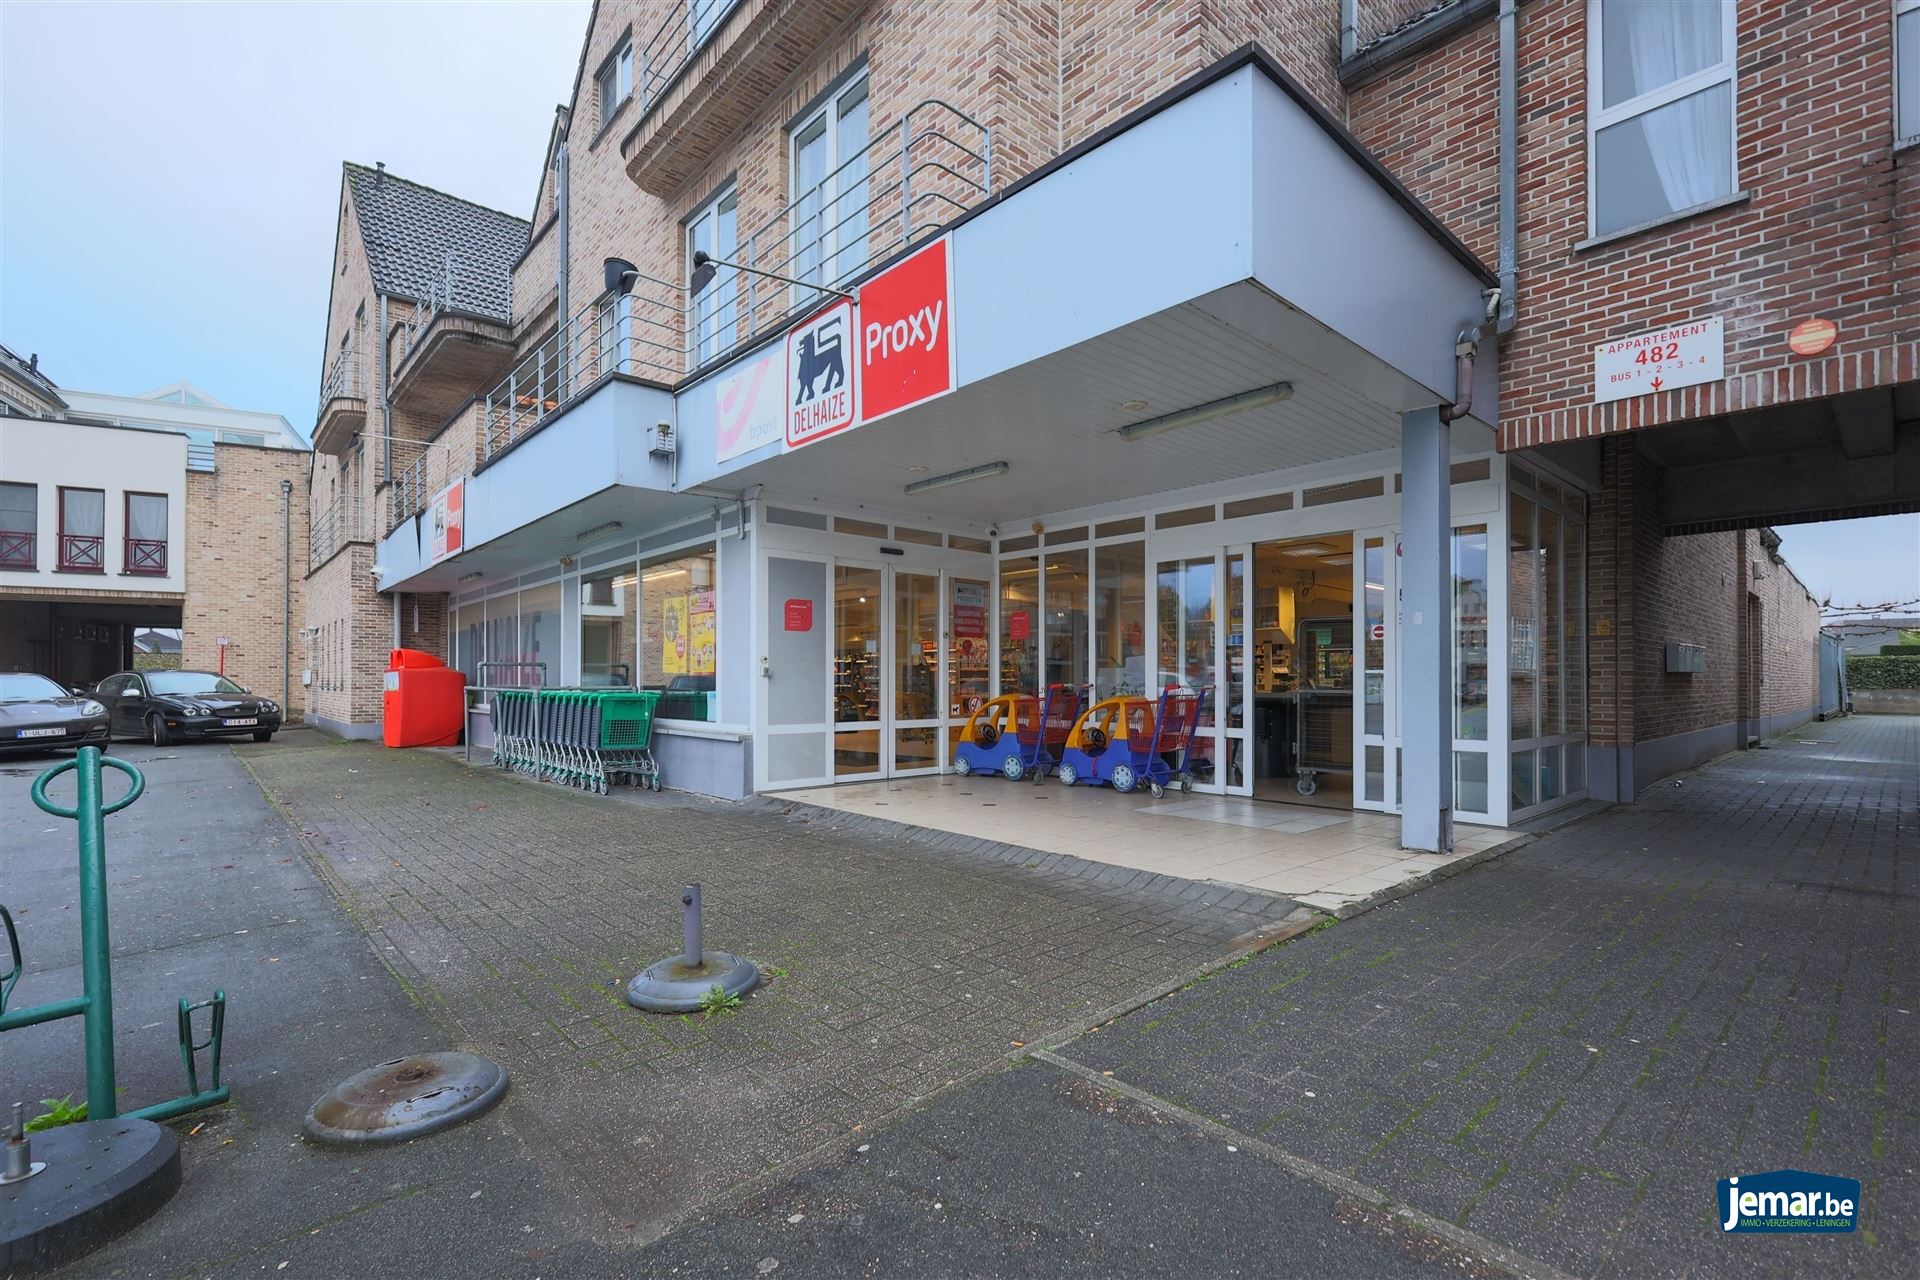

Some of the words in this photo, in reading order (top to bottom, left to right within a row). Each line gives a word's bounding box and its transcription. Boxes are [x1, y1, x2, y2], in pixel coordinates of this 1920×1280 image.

[865, 299, 943, 367] Proxy
[1608, 323, 1708, 354] APPARTEMENT
[1610, 372, 1631, 383] BUS
[1656, 364, 1662, 373] 2
[1677, 360, 1684, 369] 3
[1699, 355, 1705, 364] 4
[1635, 342, 1679, 366] 482
[793, 391, 846, 435] DELHAIZE
